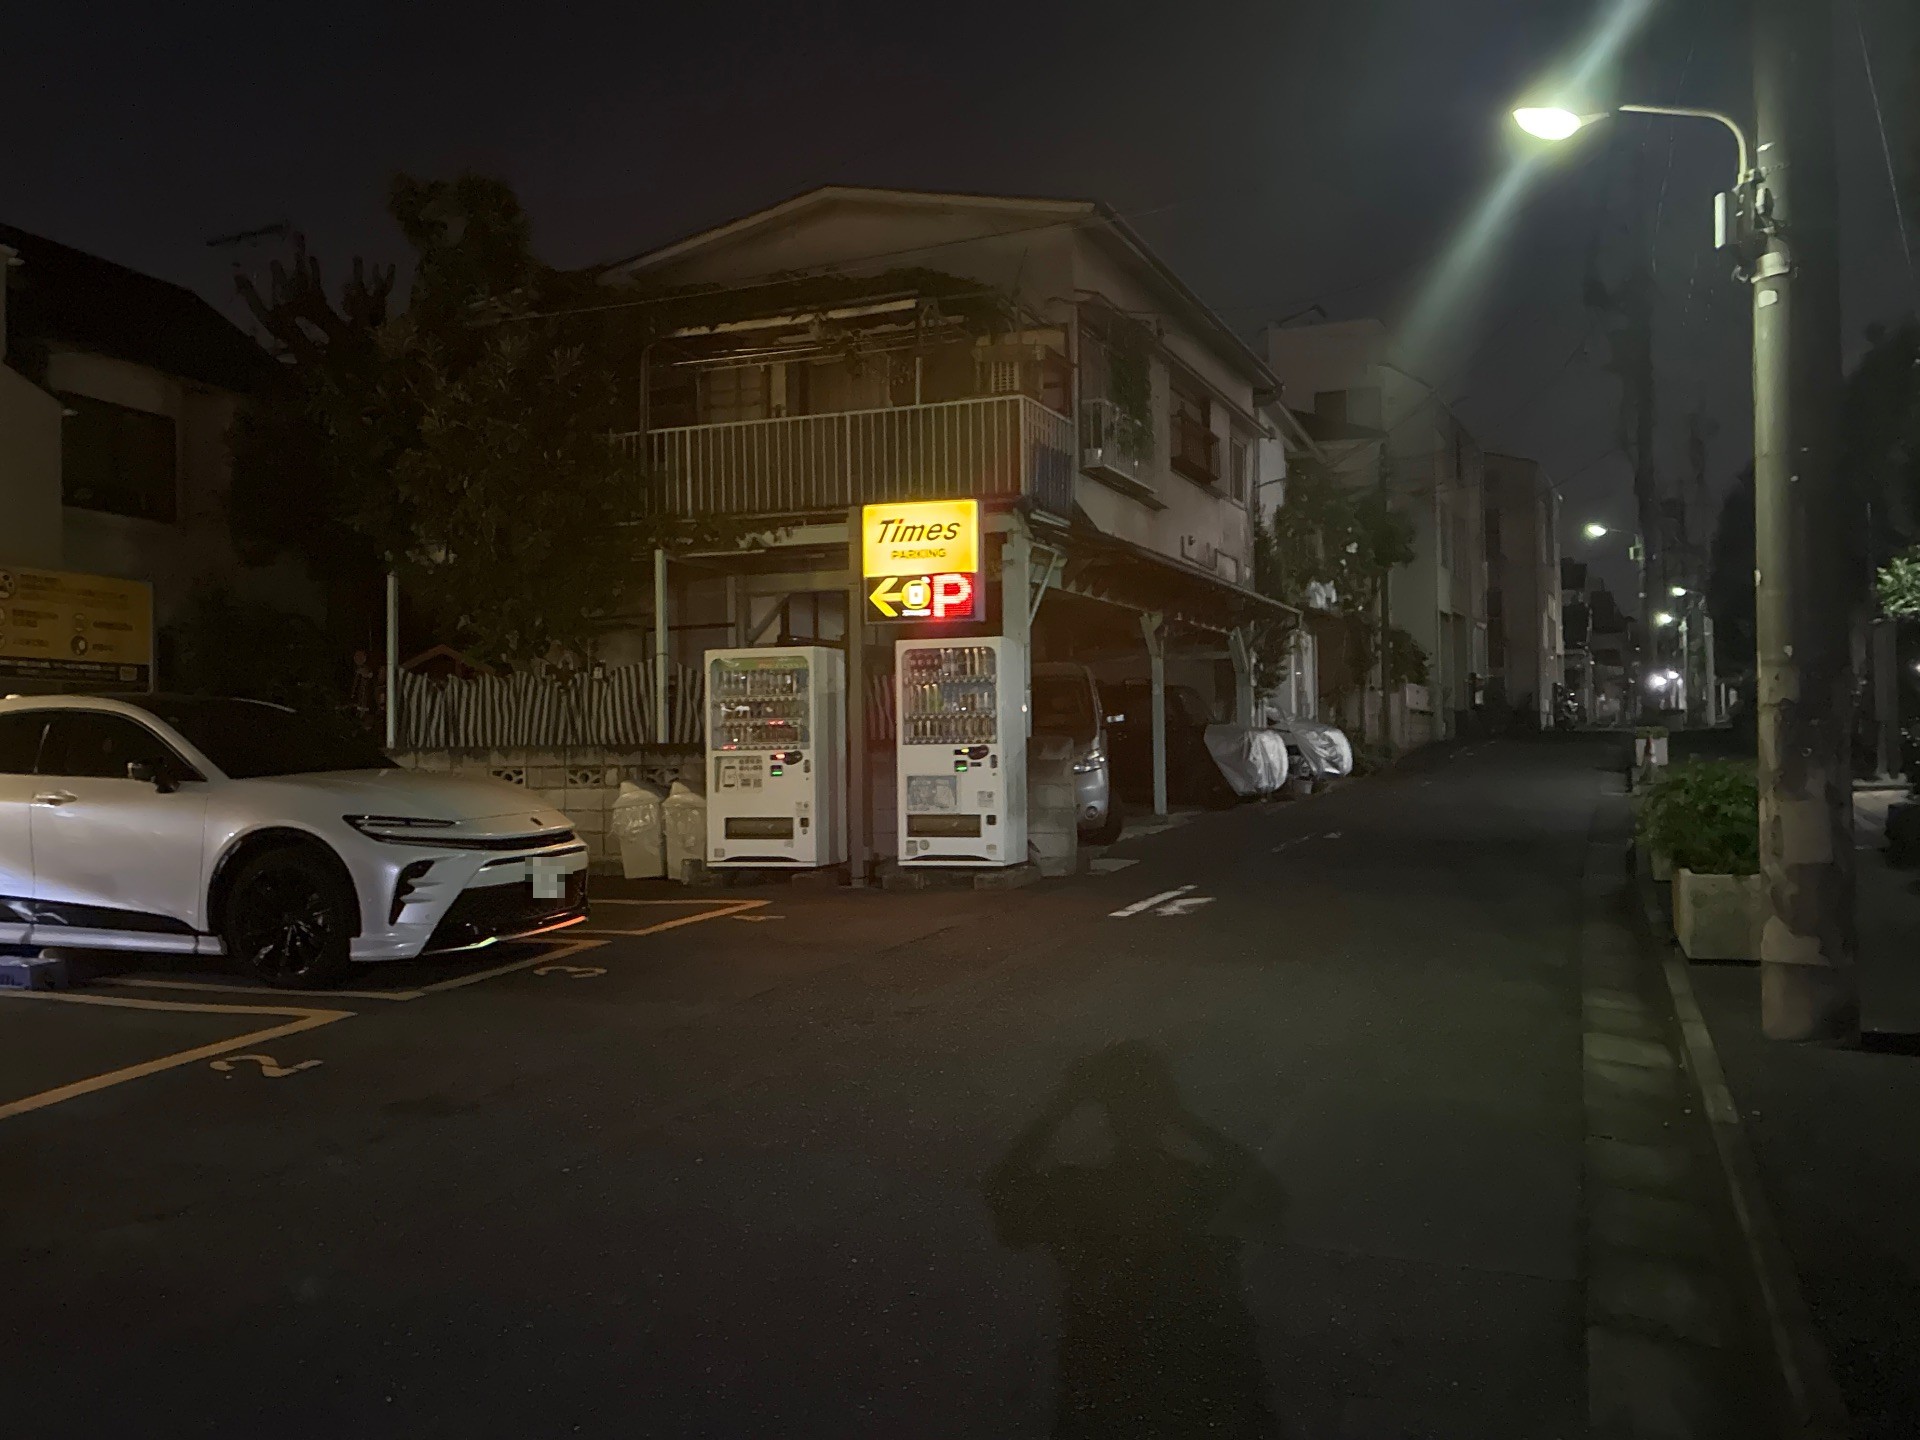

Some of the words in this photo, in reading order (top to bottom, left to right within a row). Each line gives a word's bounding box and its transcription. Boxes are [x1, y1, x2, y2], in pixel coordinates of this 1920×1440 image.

[878, 518, 961, 543] Times
[890, 548, 947, 560] PARKING
[933, 573, 972, 618] P
